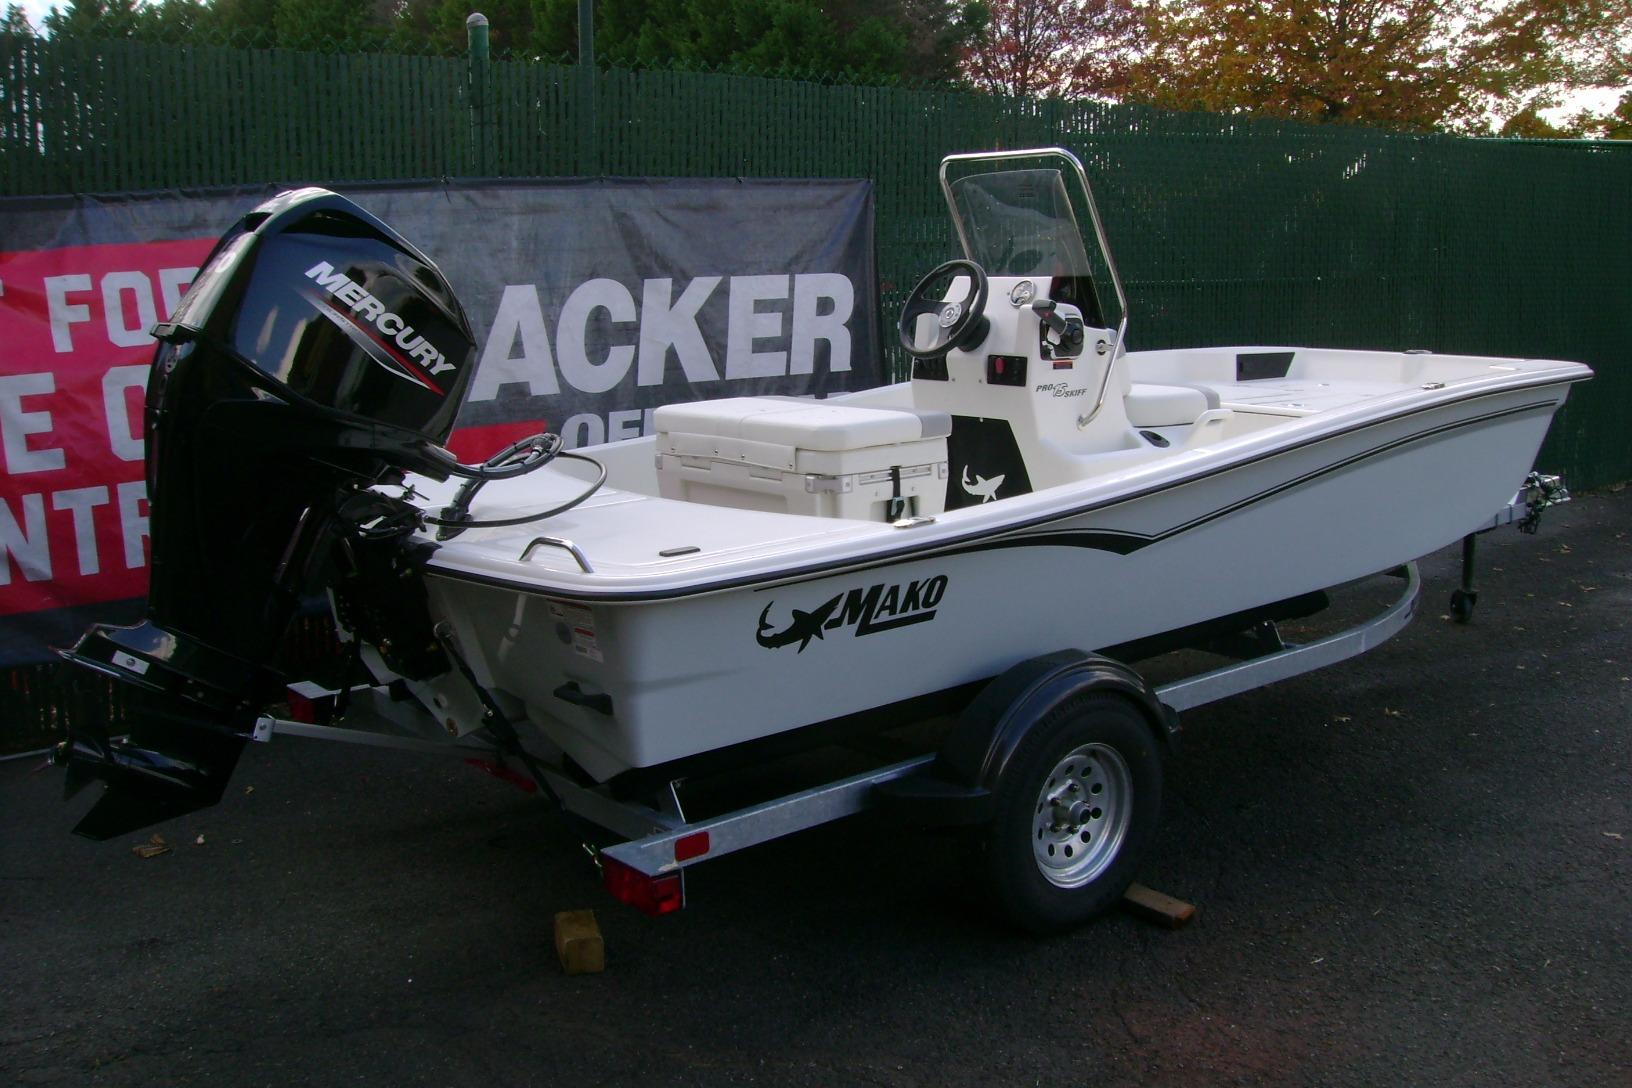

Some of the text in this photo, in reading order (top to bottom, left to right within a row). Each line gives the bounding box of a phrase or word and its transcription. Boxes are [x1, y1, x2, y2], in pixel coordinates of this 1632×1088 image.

[304, 261, 457, 376] MERCURY
[466, 273, 855, 402] ACKER
[1035, 383, 1054, 393] PRO
[1063, 388, 1088, 398] SKIFF
[824, 574, 949, 637] MAKO
